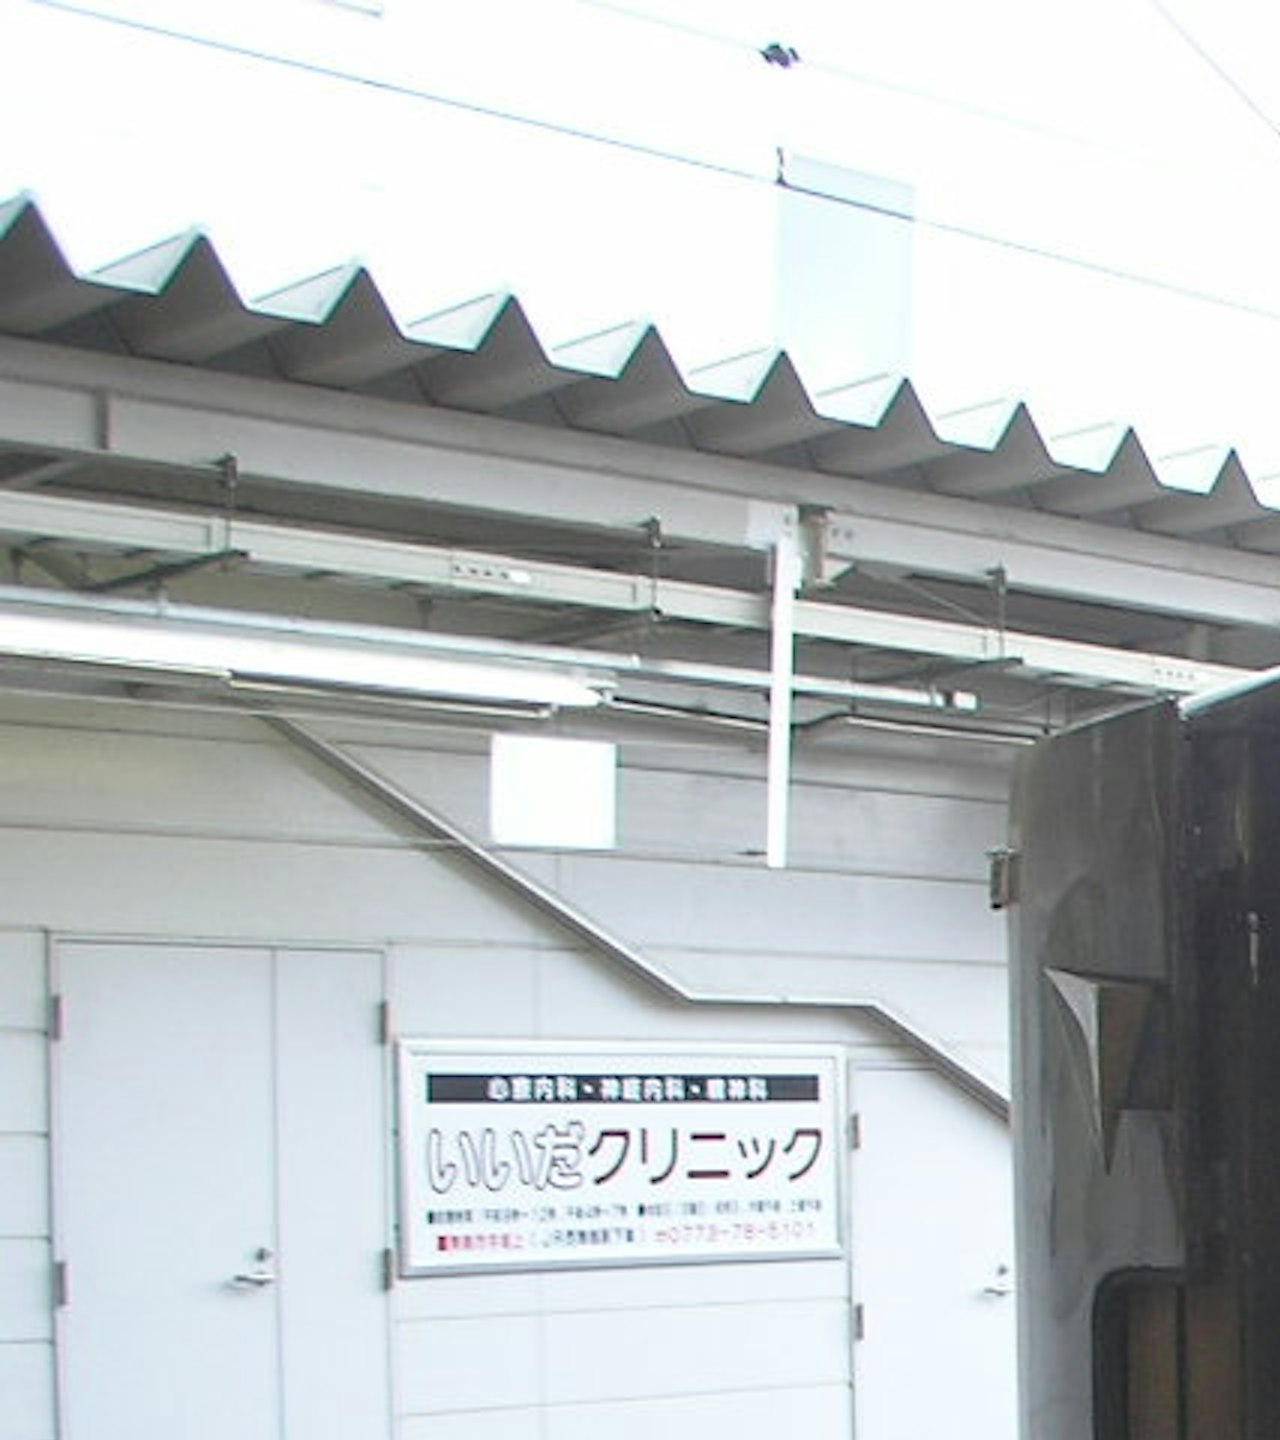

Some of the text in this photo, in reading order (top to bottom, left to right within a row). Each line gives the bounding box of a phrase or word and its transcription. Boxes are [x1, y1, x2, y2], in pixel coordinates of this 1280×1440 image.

[427, 1119, 823, 1194] いいだクリニック
